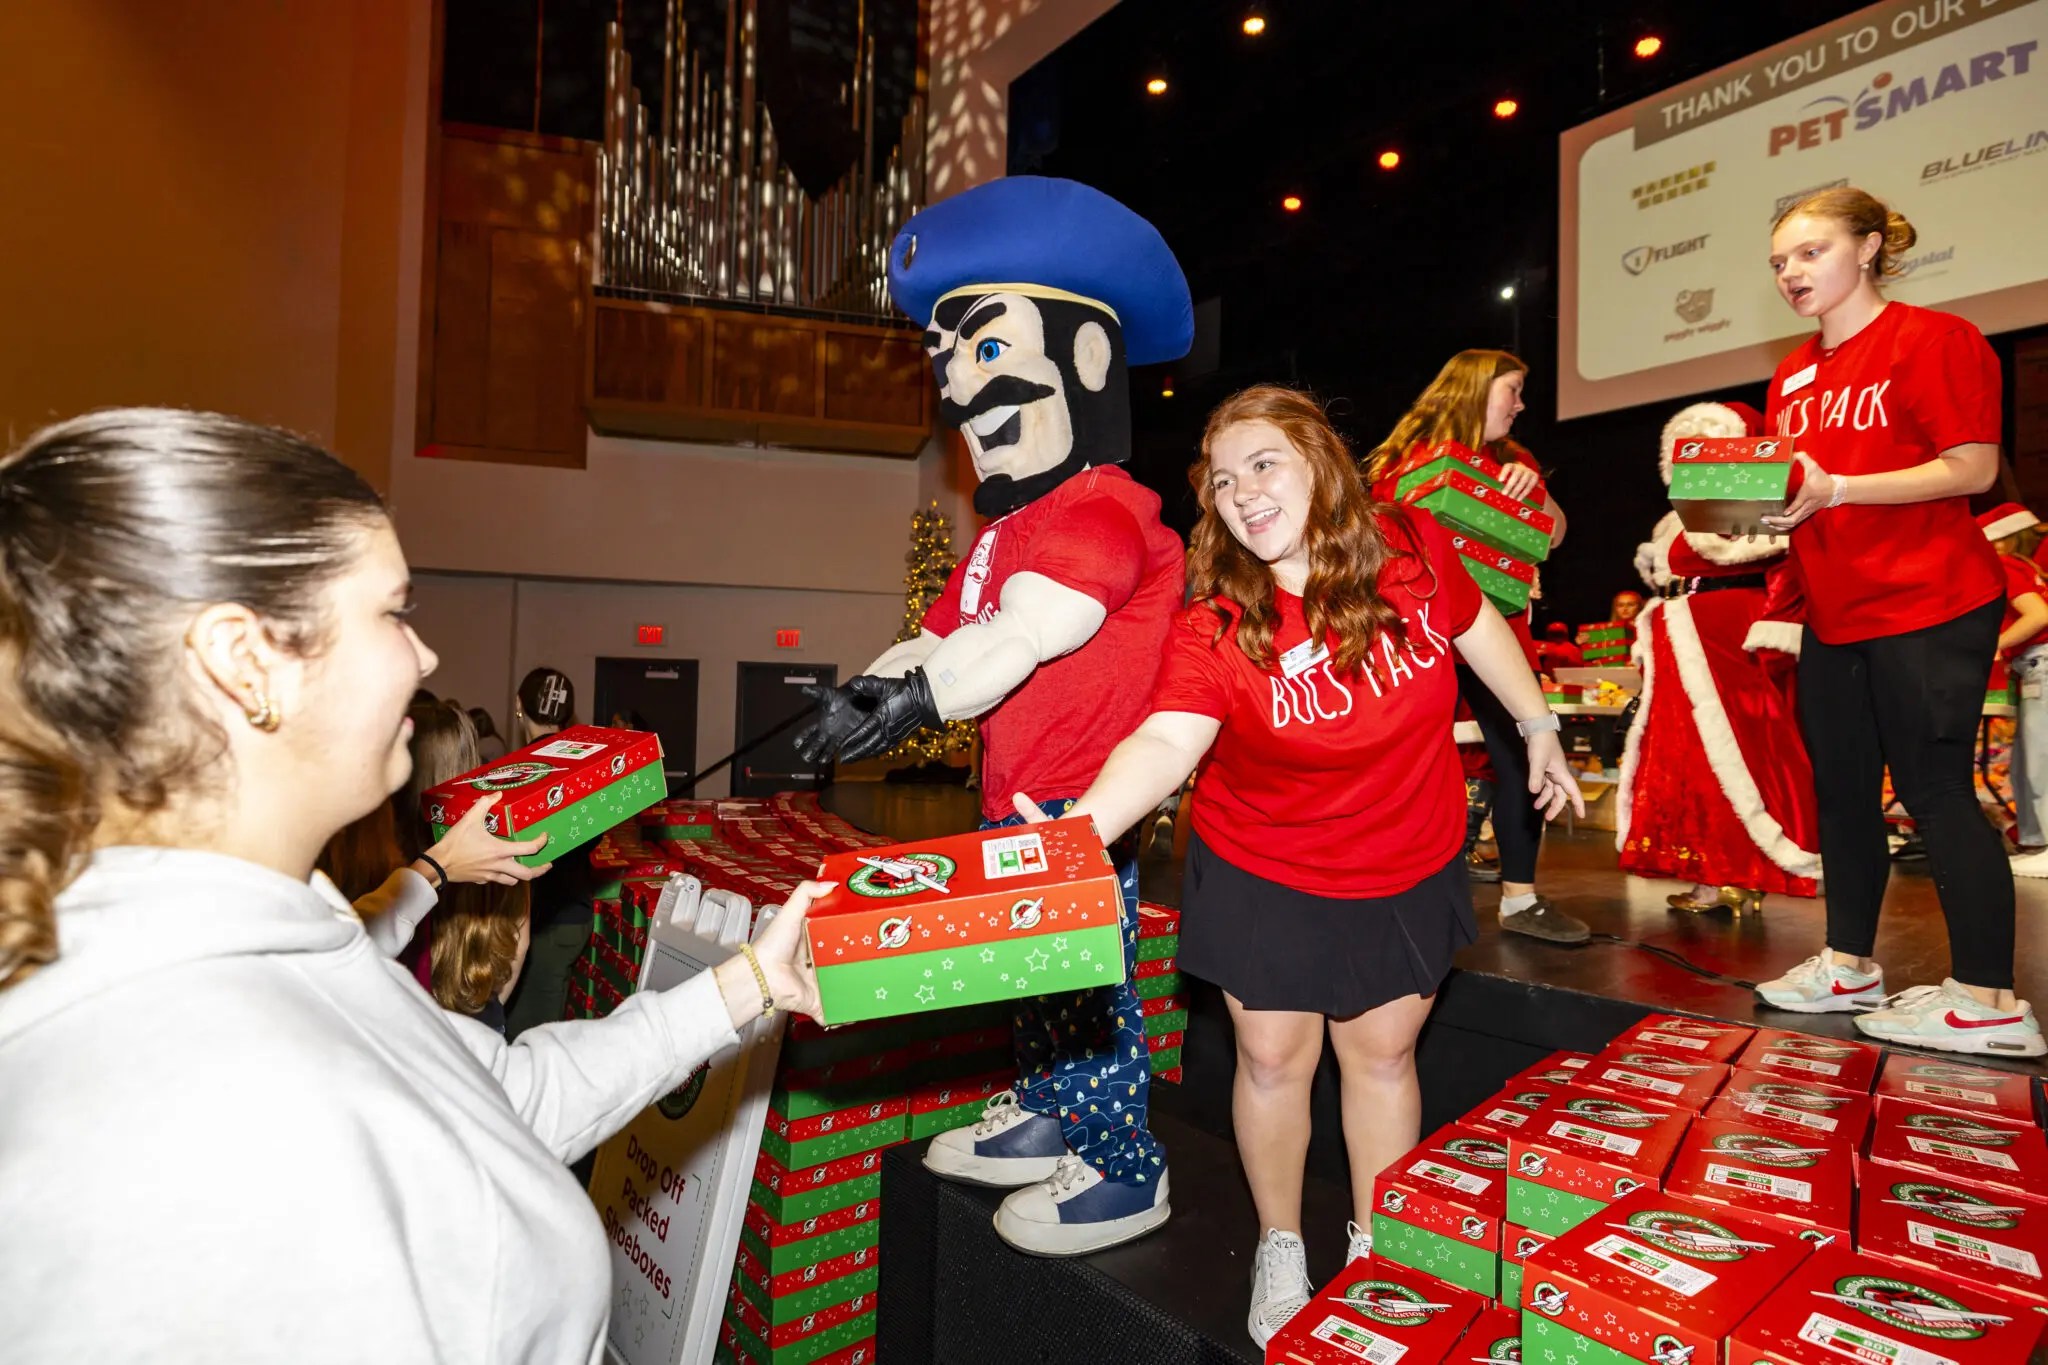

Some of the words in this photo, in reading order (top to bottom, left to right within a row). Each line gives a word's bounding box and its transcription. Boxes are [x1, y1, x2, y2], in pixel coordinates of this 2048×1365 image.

[1661, 74, 1753, 130] THANK
[1764, 45, 1827, 89] YOU
[1837, 26, 1879, 61] TO
[1891, 0, 1965, 39] OUR
[1653, 233, 1711, 263] FLIGHT
[1820, 380, 1892, 432] PACK
[638, 625, 664, 645] EXIT
[776, 629, 800, 648] EXIT
[1268, 660, 1353, 728] BUCS
[626, 1133, 658, 1184] Drop
[660, 1166, 687, 1206] Off
[621, 1175, 671, 1244] Packed
[603, 1204, 672, 1300] Shoeboxes
[1641, 1255, 1665, 1267] BOY
[1629, 1261, 1654, 1275] GIRL
[1374, 1309, 1426, 1318] OPERATION
[1344, 1340, 1363, 1351] GIRL
[1352, 1333, 1371, 1343] BOY
[1863, 1339, 1893, 1354] BOY
[1856, 1347, 1889, 1365] GIRL
